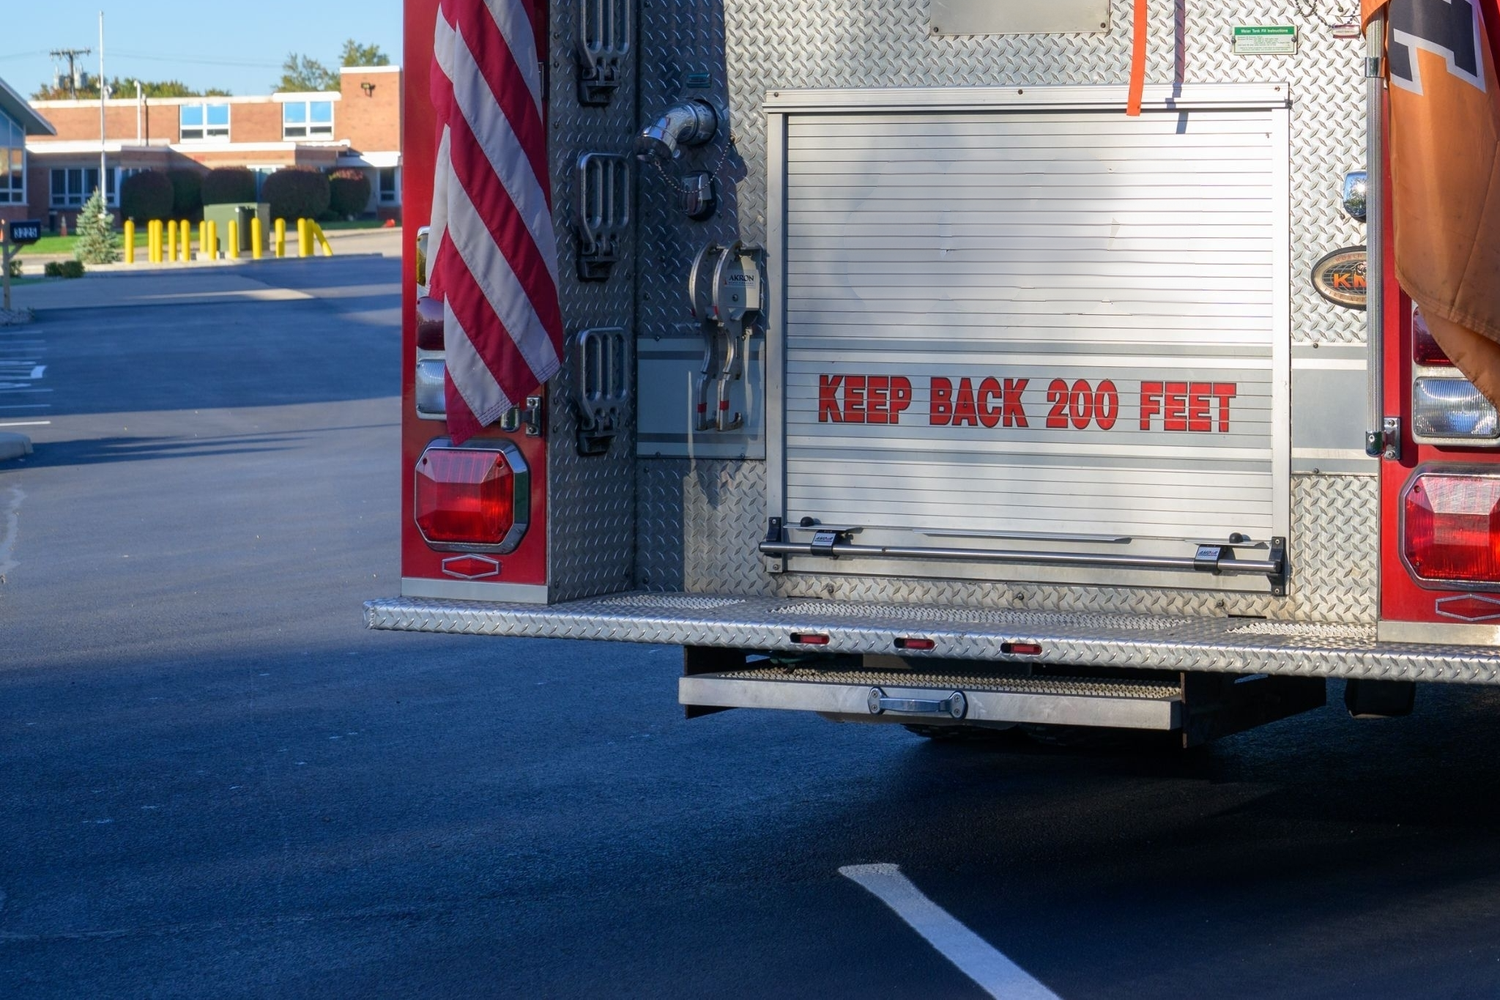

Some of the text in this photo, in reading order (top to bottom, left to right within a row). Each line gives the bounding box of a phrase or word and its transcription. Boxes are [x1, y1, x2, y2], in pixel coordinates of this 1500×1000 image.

[1333, 273, 1366, 289] KM
[818, 374, 1237, 433] KEEP BACK 200 FEET
